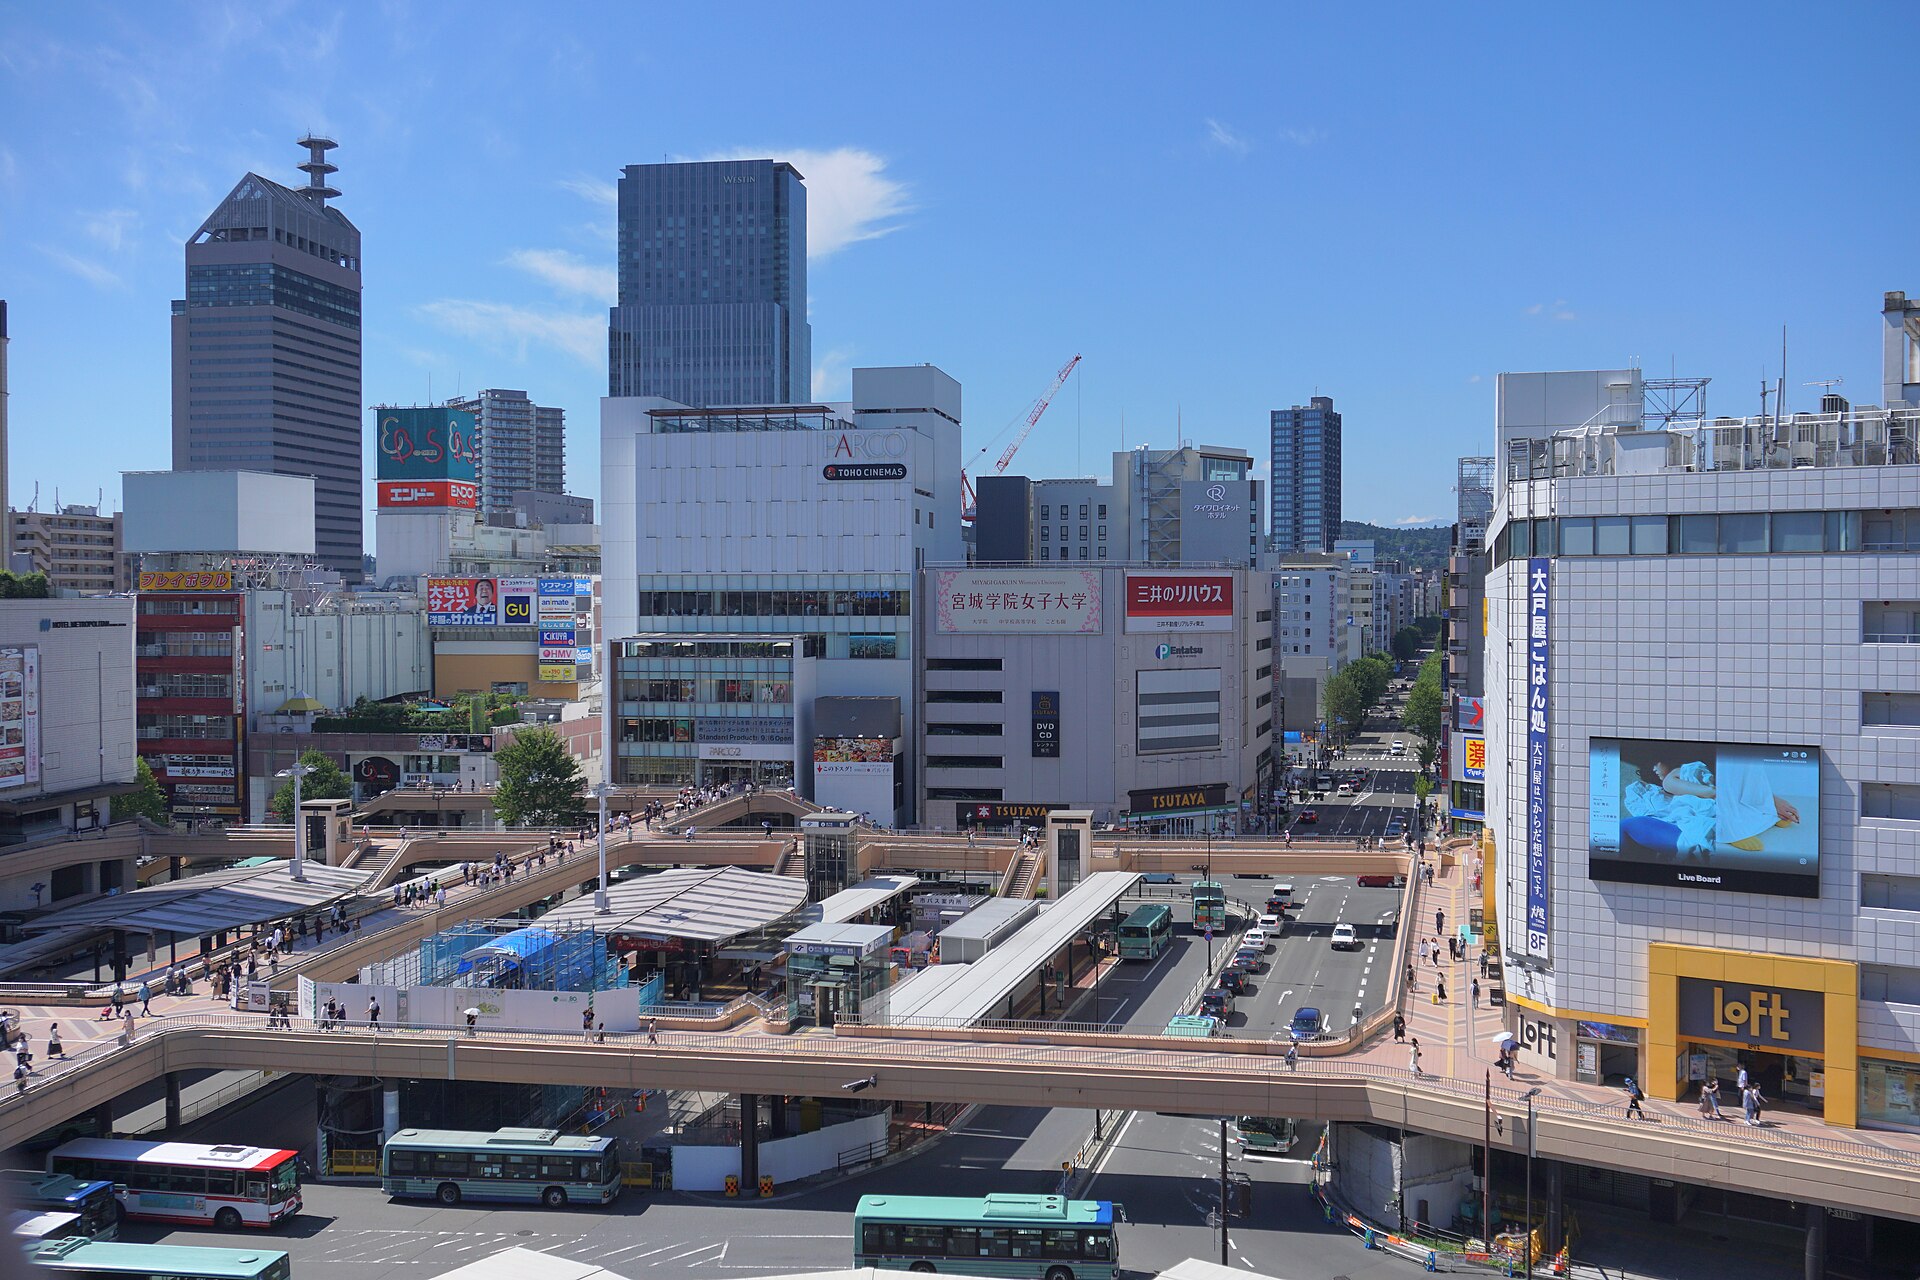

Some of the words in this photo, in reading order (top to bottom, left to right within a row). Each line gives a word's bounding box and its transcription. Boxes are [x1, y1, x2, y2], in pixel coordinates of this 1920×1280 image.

[823, 431, 907, 459] PARCO
[838, 468, 861, 477] TOHO
[864, 467, 903, 477] CINEMAS
[450, 484, 474, 499] ENDO
[141, 573, 228, 588] プレイボウル
[540, 581, 574, 589] ソフマップ
[429, 585, 470, 599] 大きい
[1137, 584, 1223, 603] 三井のリハウス
[429, 598, 470, 612] サイズ
[951, 592, 1087, 611] 宮城学院女子大学
[505, 603, 529, 617] GU
[429, 613, 496, 625] 洋服のサカゼン
[550, 649, 573, 658] HMV
[1170, 645, 1203, 655] Entatsu
[1531, 568, 1547, 734] 大戸屋ごはん処
[1039, 731, 1053, 739] CD
[1152, 792, 1206, 809] TSUTAYA
[978, 805, 990, 818] 本
[996, 806, 1048, 817] TSUTAYA
[1531, 741, 1544, 899] 大戸屋は「からだ想い」です。
[1678, 872, 1696, 882] Live
[1696, 874, 1721, 884] Board
[1530, 932, 1547, 951] 8F
